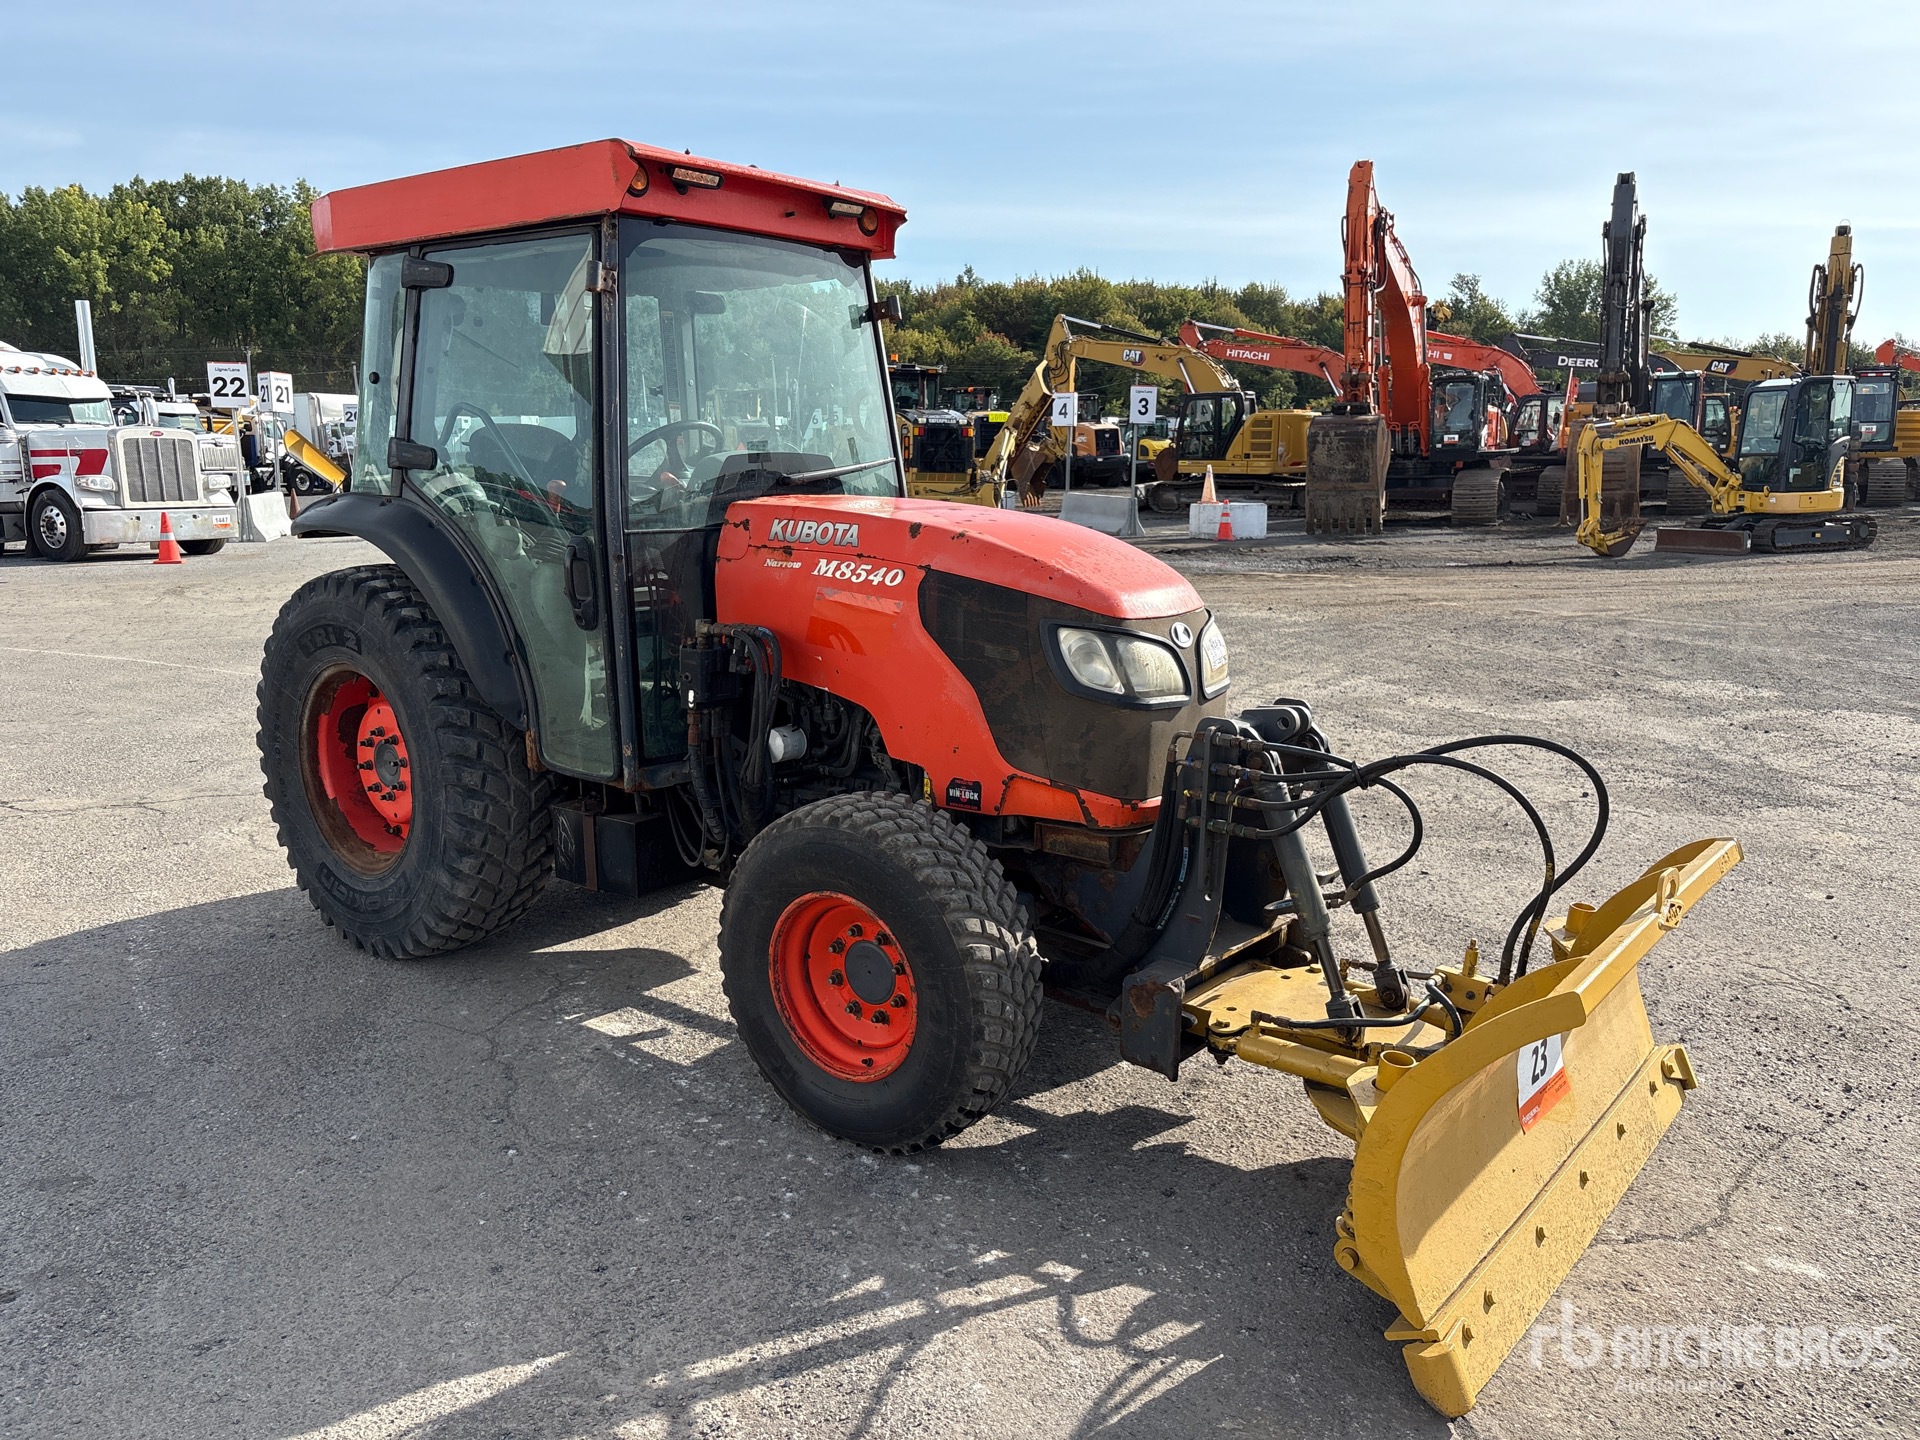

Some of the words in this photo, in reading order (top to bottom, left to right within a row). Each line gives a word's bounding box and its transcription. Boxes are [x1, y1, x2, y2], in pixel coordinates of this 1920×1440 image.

[1122, 349, 1142, 362] CAT
[1226, 348, 1270, 361] HITACHI
[1710, 360, 1731, 373] CAT
[212, 376, 247, 398] 22
[260, 384, 270, 403] 21
[275, 385, 290, 404] 21
[1058, 402, 1068, 419] 4
[1137, 398, 1149, 416] 3
[811, 414, 818, 424] 6
[1619, 434, 1654, 446] KOMATSU
[768, 518, 860, 547] KUBOTA
[764, 558, 802, 569] Narrow
[811, 558, 906, 587] M8540
[1531, 1038, 1548, 1086] 23
